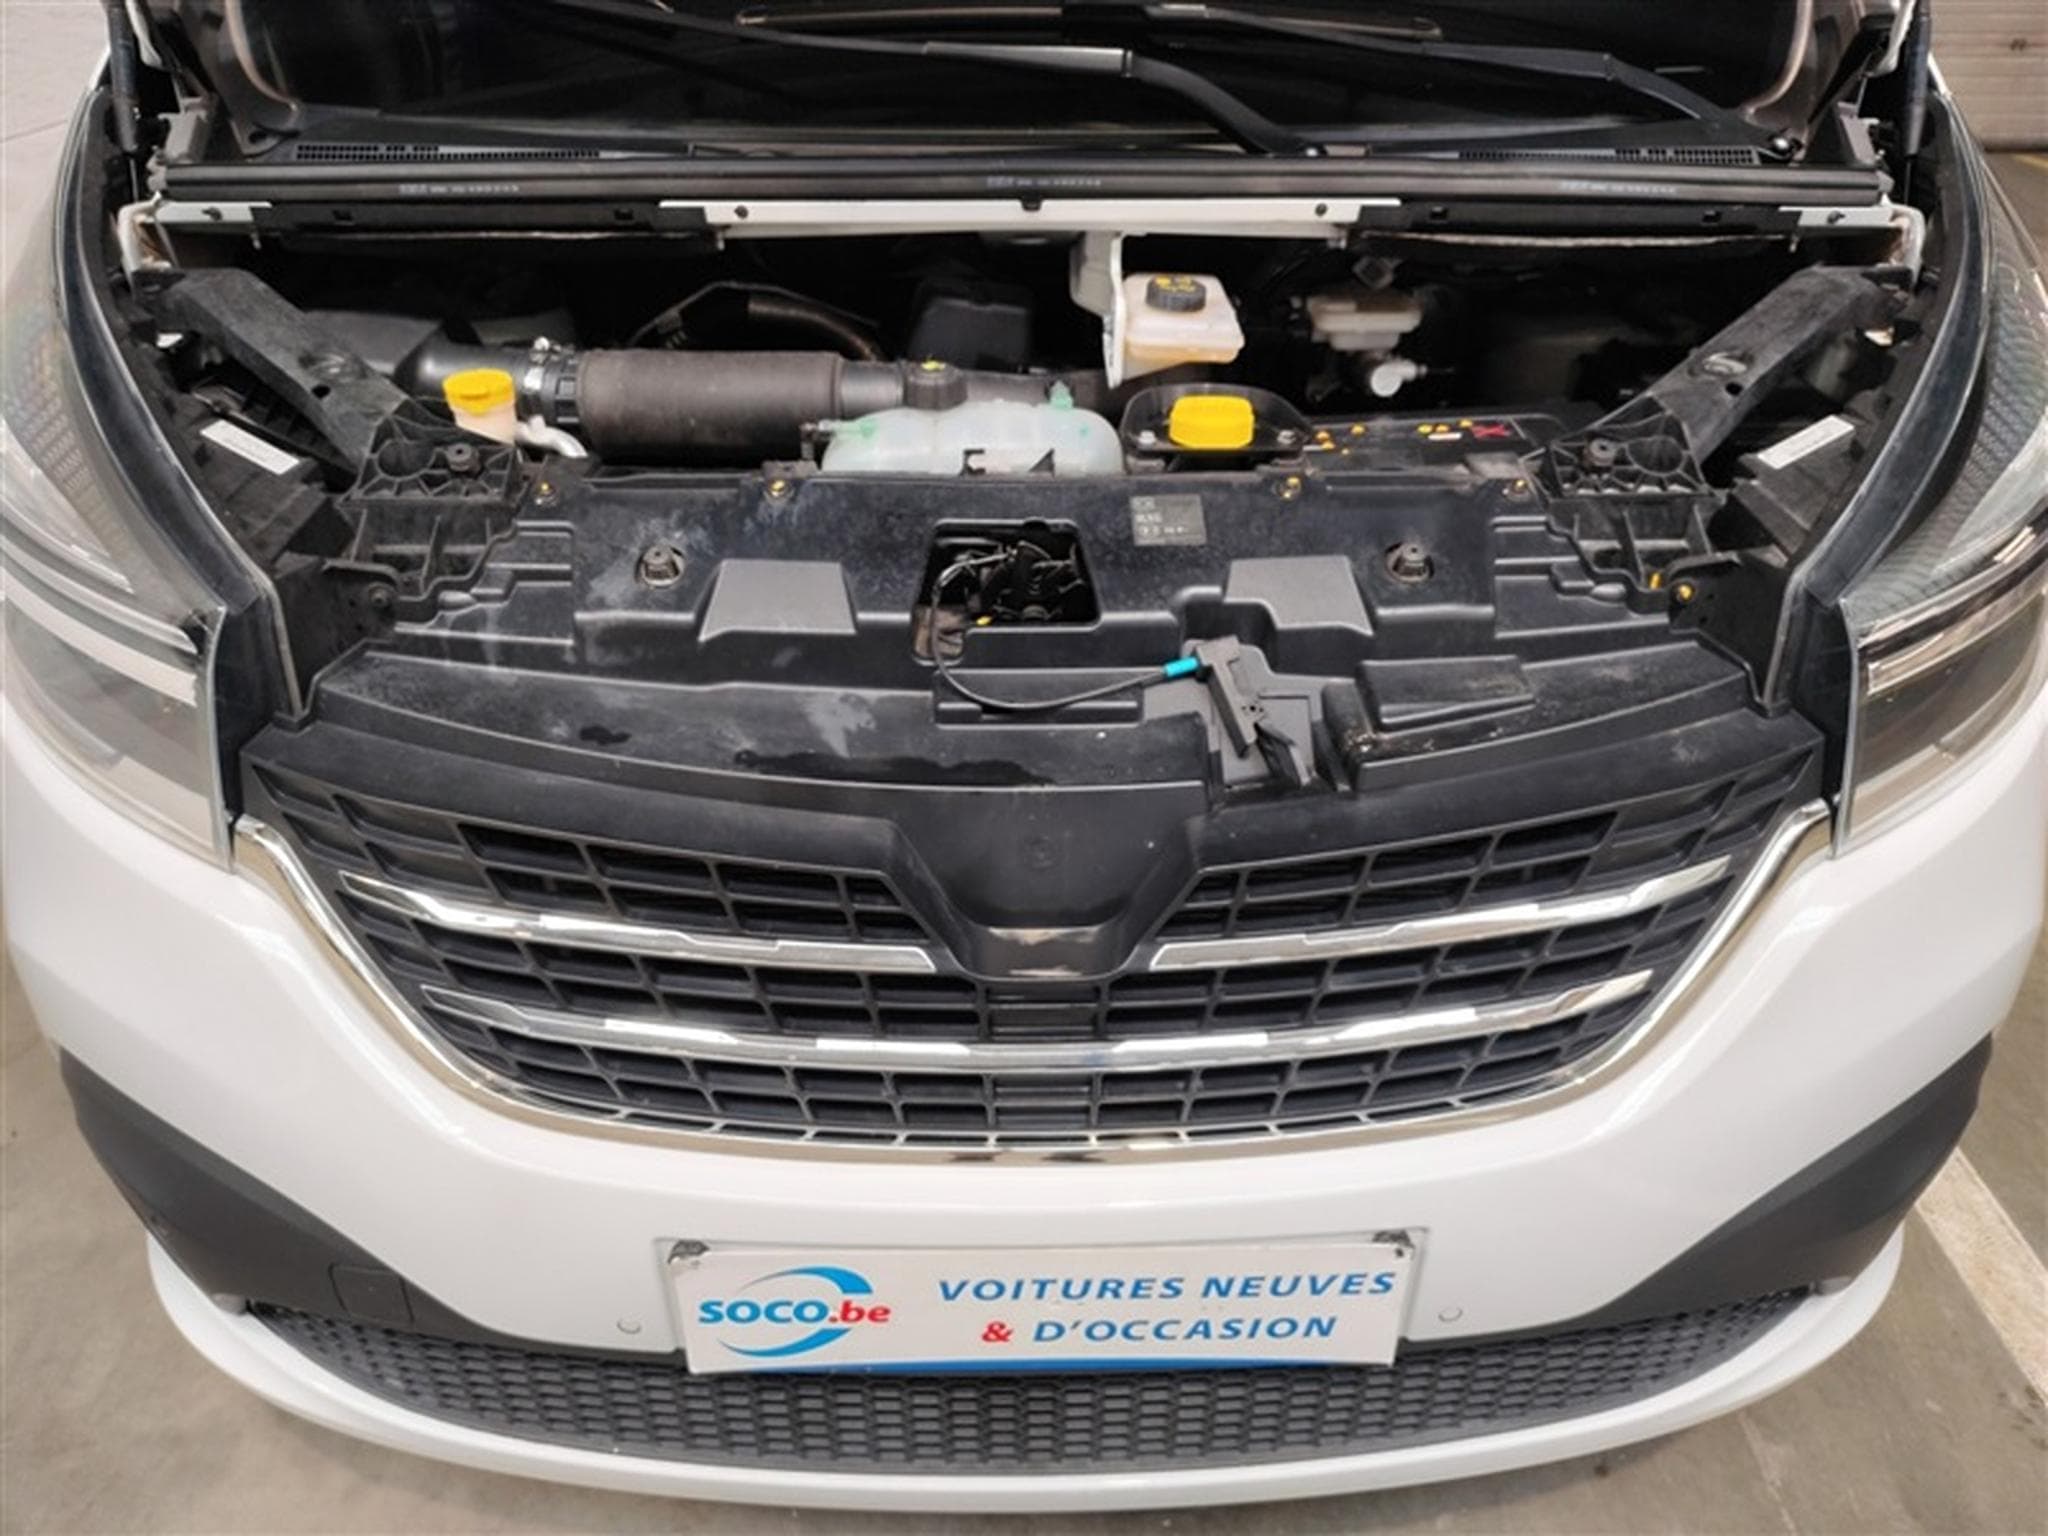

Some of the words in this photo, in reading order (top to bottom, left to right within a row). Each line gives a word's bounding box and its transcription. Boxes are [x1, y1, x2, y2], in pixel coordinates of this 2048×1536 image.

[939, 1278, 1184, 1301] VOITURES
[1201, 1272, 1395, 1298] NEUVES
[699, 1300, 891, 1324] SOCO.be
[981, 1321, 1013, 1343] &
[1033, 1316, 1336, 1342] D'OCCASION
